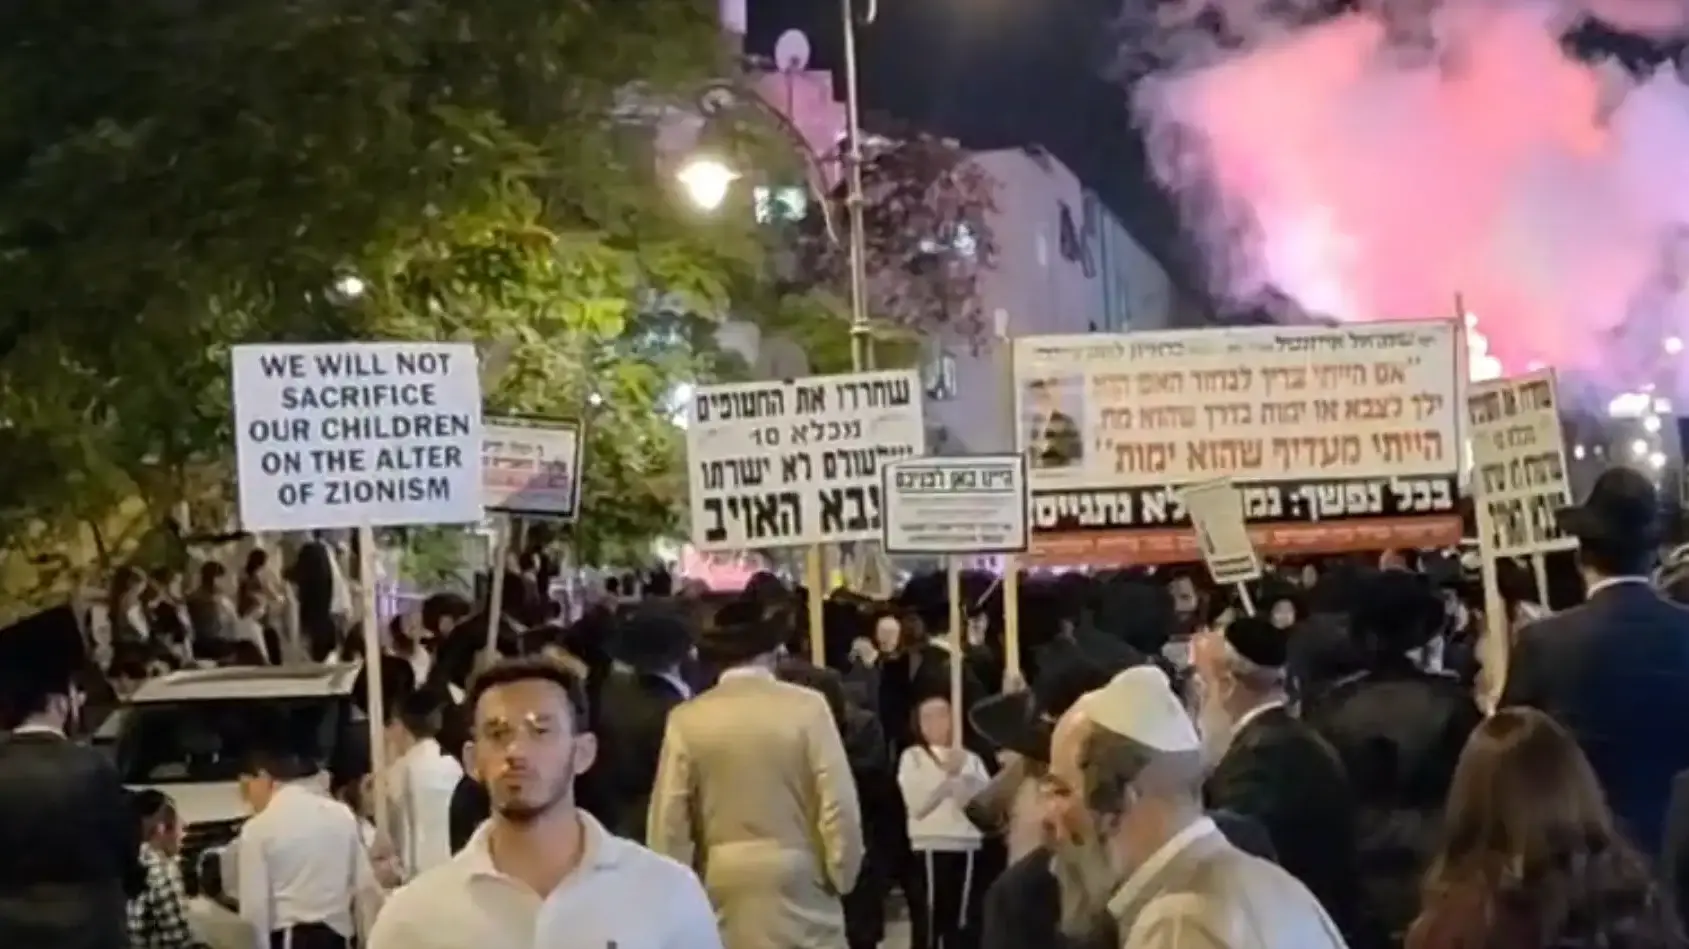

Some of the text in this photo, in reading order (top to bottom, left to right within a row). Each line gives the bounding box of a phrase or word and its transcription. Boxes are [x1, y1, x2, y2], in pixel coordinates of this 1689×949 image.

[259, 352, 452, 378] WE WILL NOT
[281, 383, 437, 409] SACRIFICE
[697, 377, 910, 422] שחררו את החטופים
[249, 414, 470, 442] OUR CHILDREN
[749, 419, 862, 445] מכלא 10
[1203, 402, 1251, 433] בדרך
[261, 451, 301, 475] ON
[310, 448, 366, 472] THE
[376, 446, 462, 471] ALTER
[1187, 437, 1263, 472] שהוא
[1272, 434, 1361, 471] מעדיף
[1371, 430, 1443, 463] הייתי
[701, 456, 772, 489] ישרתו
[782, 451, 811, 483] לא
[278, 481, 314, 506] OF
[324, 476, 451, 504] ZIONISM
[1142, 484, 1188, 524] לא
[1243, 486, 1284, 517] נמ
[1290, 483, 1384, 523] נפשך:
[1389, 476, 1453, 511] בכל
[704, 491, 802, 542] האויב
